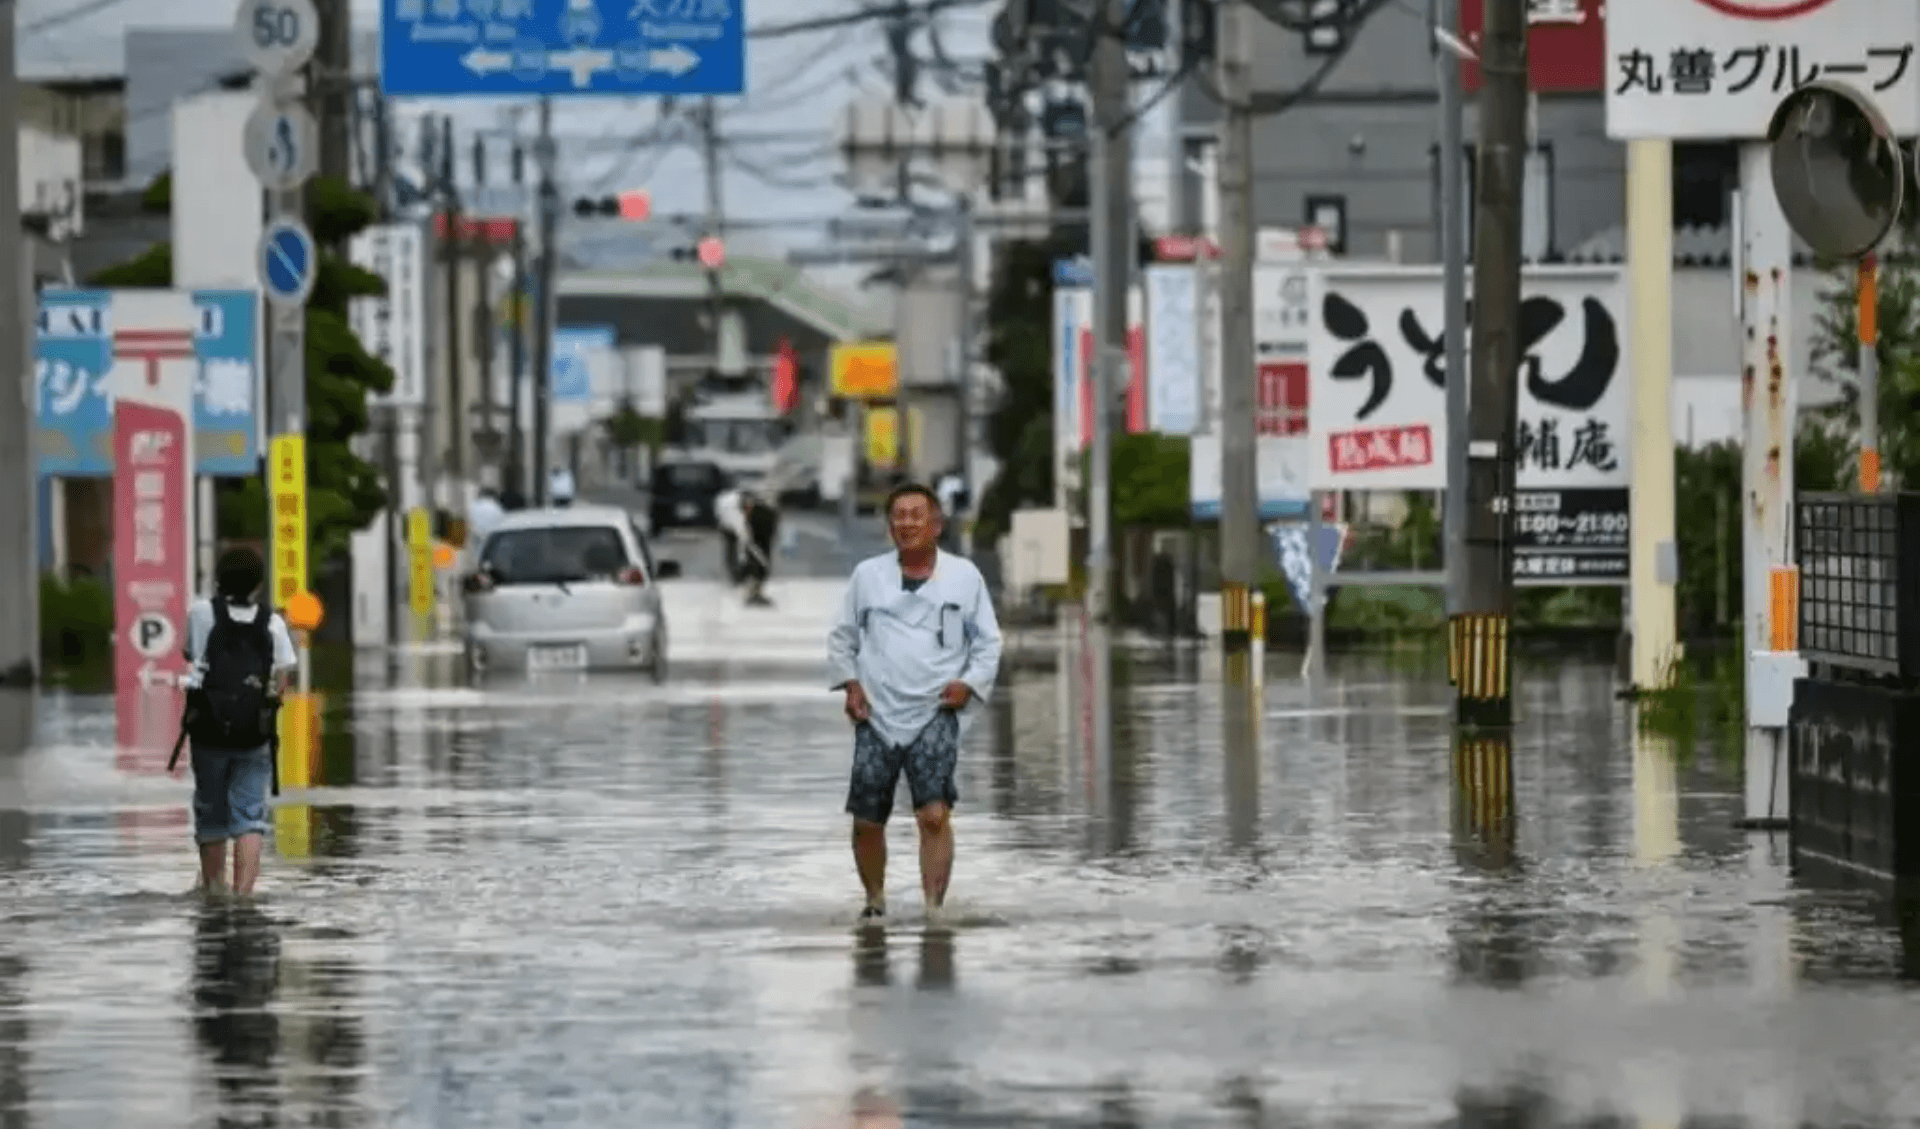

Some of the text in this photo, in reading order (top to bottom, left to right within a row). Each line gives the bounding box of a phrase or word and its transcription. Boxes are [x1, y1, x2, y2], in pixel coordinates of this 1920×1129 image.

[253, 8, 299, 48] 50
[1616, 45, 1914, 94] 丸善グループ
[141, 619, 163, 649] P
